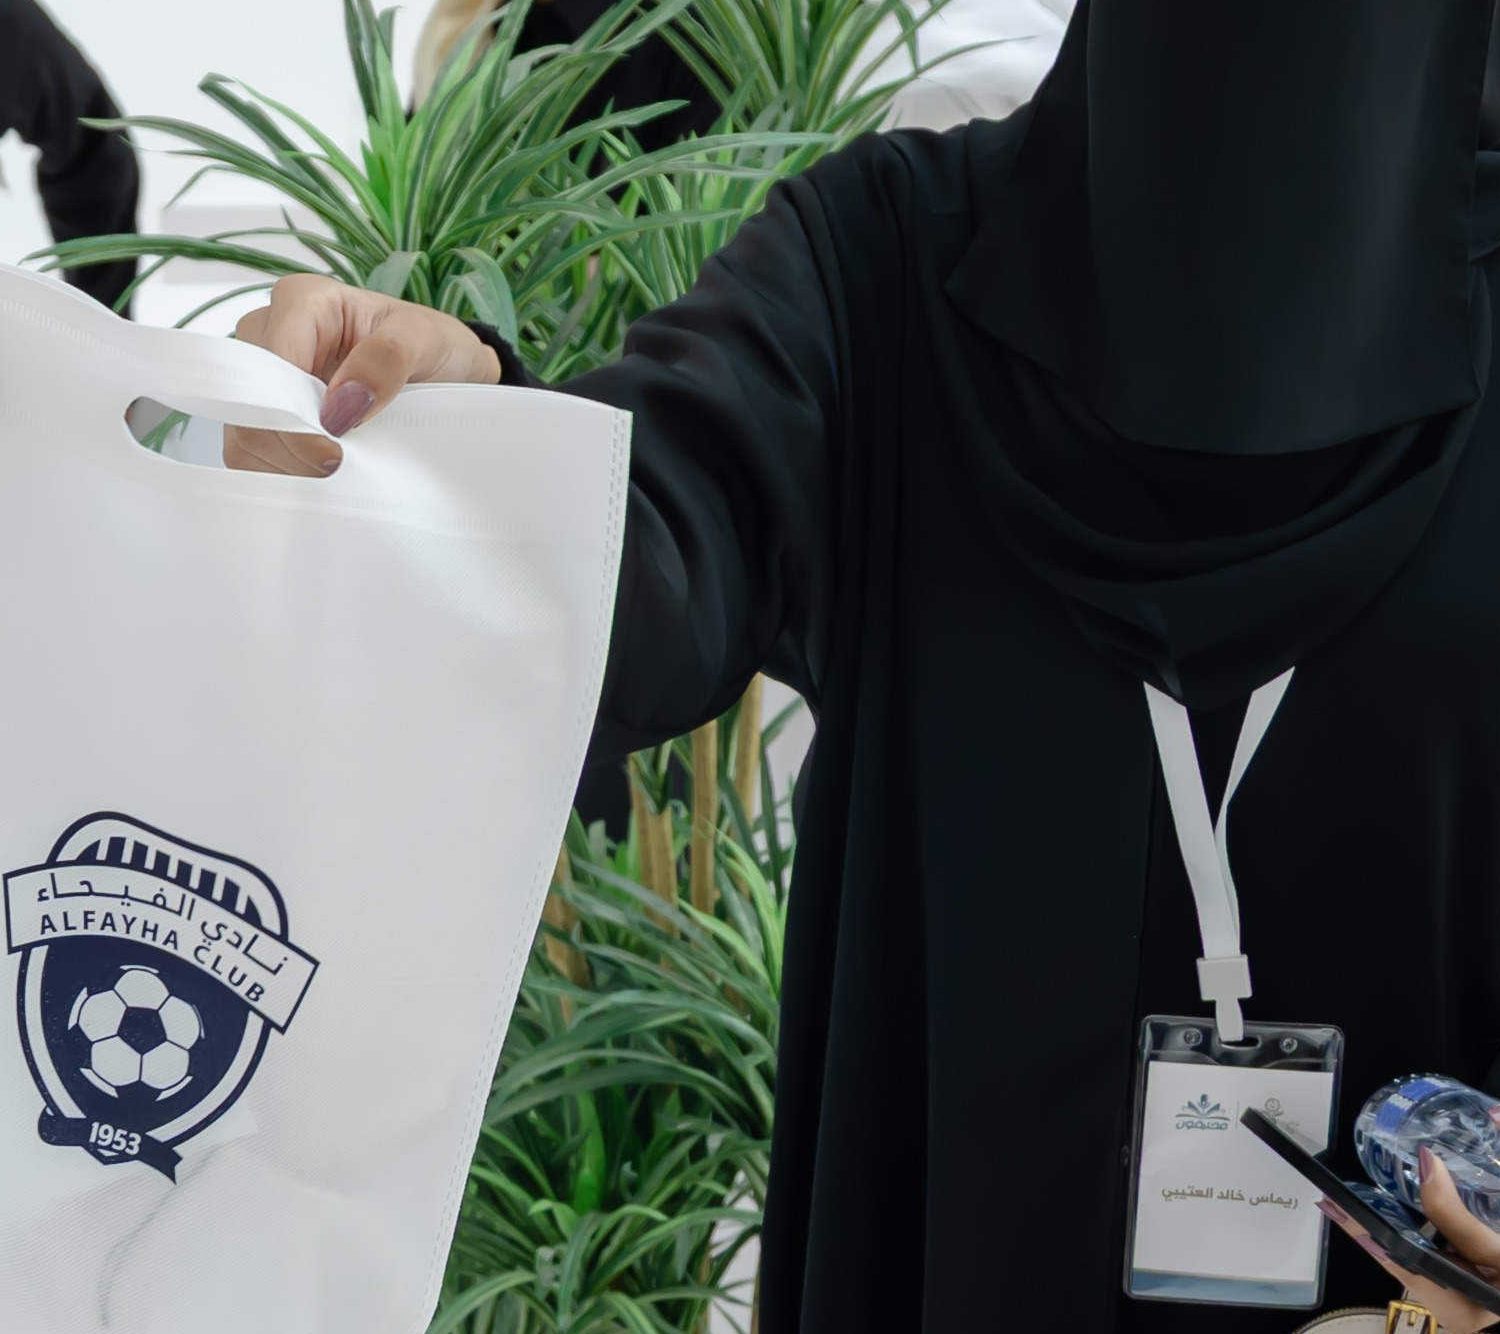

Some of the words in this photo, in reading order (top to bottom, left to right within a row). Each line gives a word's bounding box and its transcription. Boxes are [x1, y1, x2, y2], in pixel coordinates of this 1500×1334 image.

[37, 873, 196, 921] الفيحاء
[39, 910, 180, 951] ALFAYHA
[193, 944, 266, 1004] CLUB
[200, 920, 288, 975] نادي
[88, 1121, 142, 1156] 1953
[1161, 1185, 1214, 1203] العتيبي
[1216, 1188, 1245, 1201] خالد
[1249, 1192, 1299, 1210] ريماس
